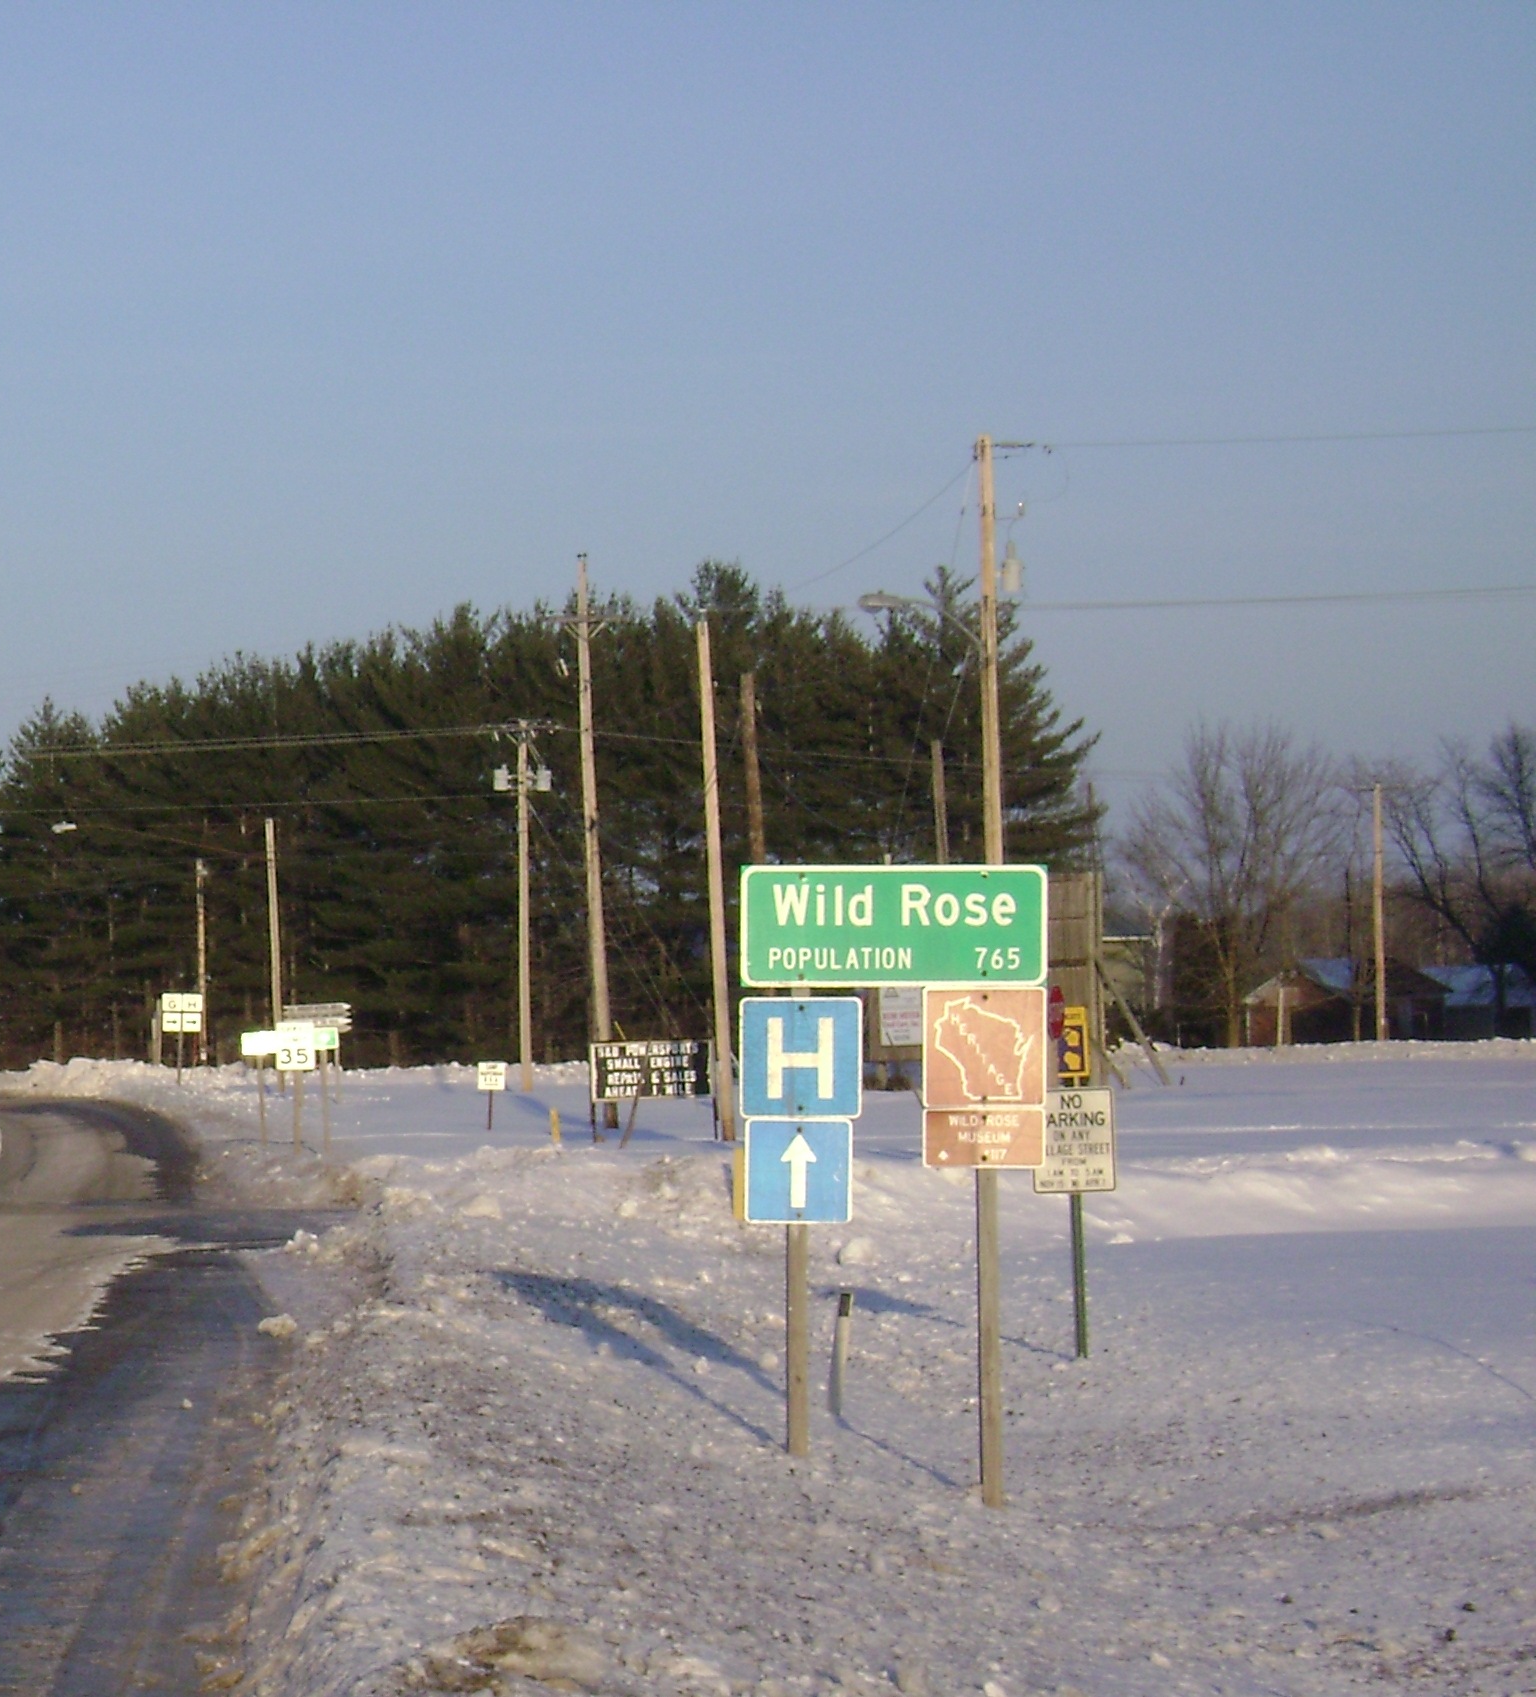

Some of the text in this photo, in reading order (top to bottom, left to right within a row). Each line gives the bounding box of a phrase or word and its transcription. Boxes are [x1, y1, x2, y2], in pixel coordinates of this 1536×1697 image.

[772, 883, 1017, 927] Wild Rose
[768, 947, 1021, 971] POPULATION 765
[280, 1048, 308, 1064] 35
[766, 1016, 835, 1099] H
[950, 1013, 1013, 1096] HERITAGE
[607, 1056, 690, 1070] SMALL ENGINE
[664, 1070, 697, 1082] SALES
[665, 1082, 693, 1095] MILE
[1060, 1094, 1082, 1109] NO
[948, 1114, 1020, 1126] WILD ROSE
[1046, 1111, 1106, 1128] ARKING
[958, 1131, 1012, 1143] MUSEUM
[1046, 1144, 1073, 1156] LLAGE
